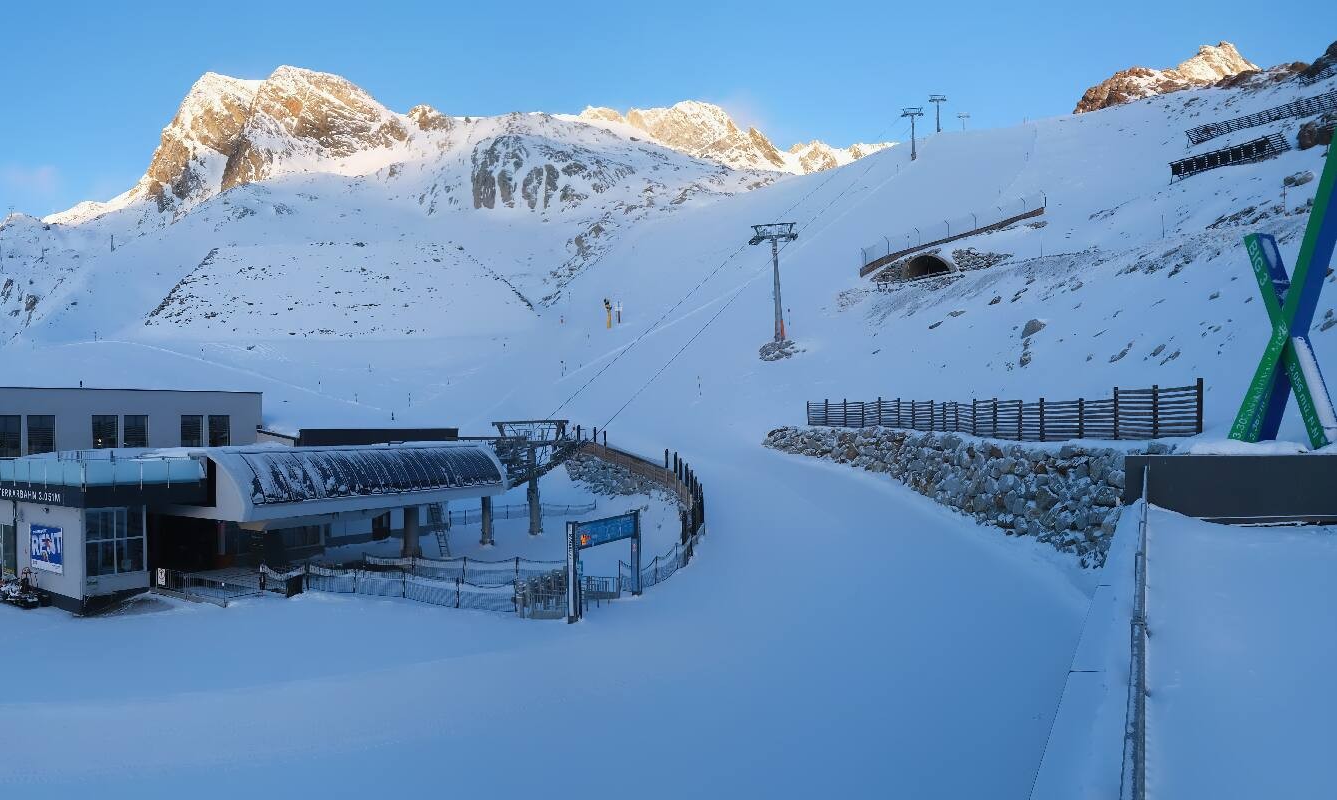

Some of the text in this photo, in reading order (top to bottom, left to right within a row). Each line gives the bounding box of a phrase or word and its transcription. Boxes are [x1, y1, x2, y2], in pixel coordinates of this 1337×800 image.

[1248, 240, 1268, 286] BIG 3
[31, 532, 62, 556] RENT
